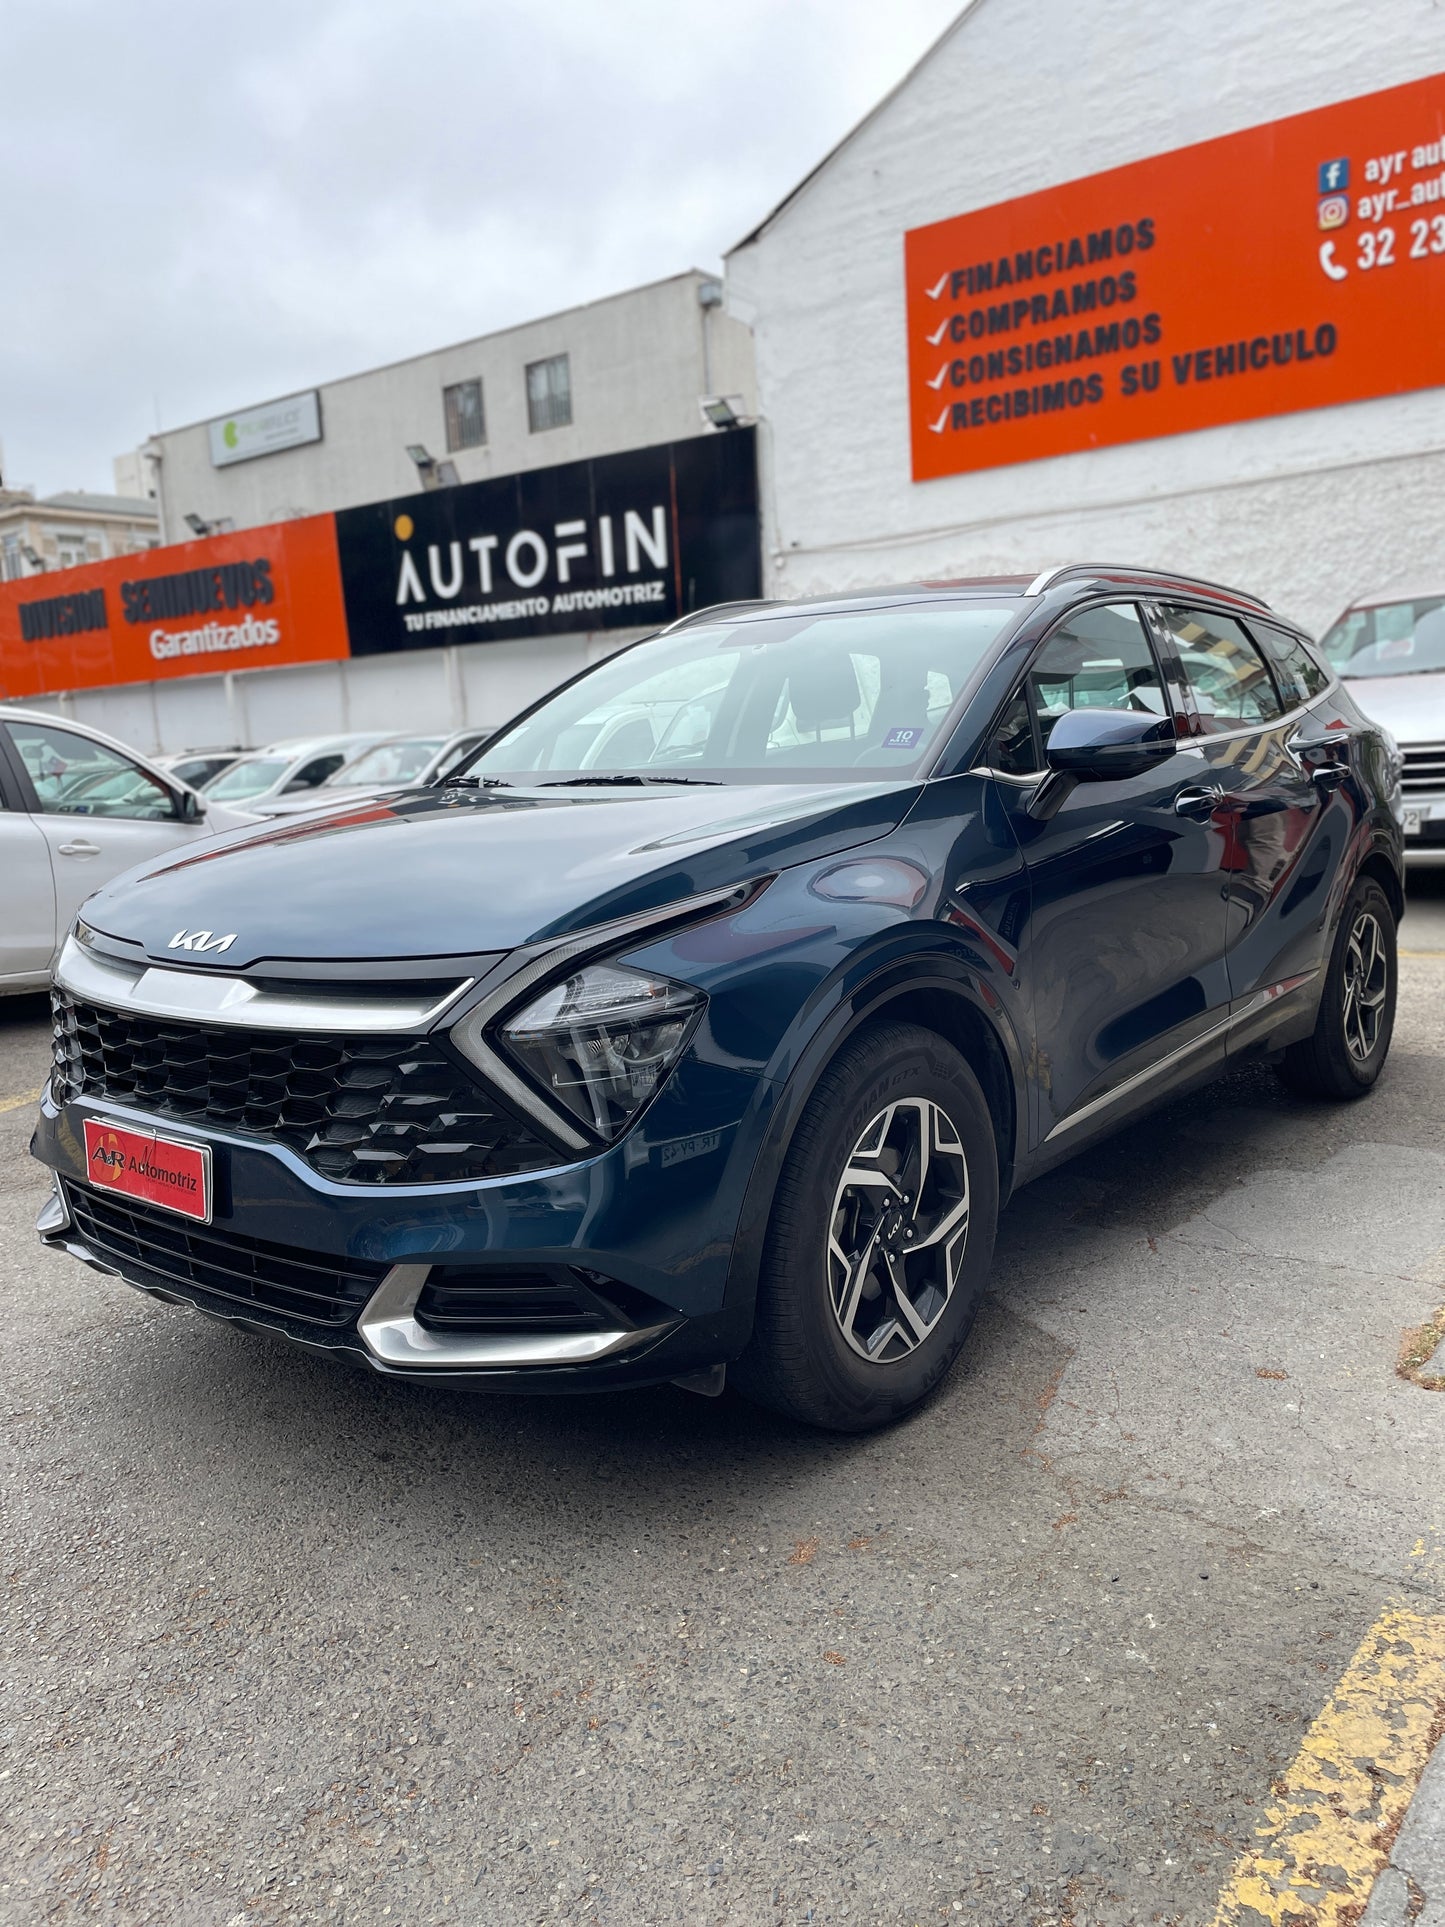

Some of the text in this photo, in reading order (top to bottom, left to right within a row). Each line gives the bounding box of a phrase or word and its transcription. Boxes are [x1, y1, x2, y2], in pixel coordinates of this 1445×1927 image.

[1365, 151, 1407, 185] ayr
[950, 218, 1156, 299] FINANCIAMOS
[1357, 214, 1445, 270] 32 23
[950, 271, 1137, 344] COMPRAMOS
[950, 314, 1162, 388] CONSIGNAMOS
[952, 323, 1337, 432] RECIBIMOS SU VEHICULO
[397, 506, 668, 605] AUTOFIN
[404, 581, 665, 632] TU FINANCIAMIENTO AUTOMOTRIZ
[149, 613, 280, 660] Garantizados
[168, 928, 239, 955] KIA
[128, 1156, 197, 1192] Automotriz
